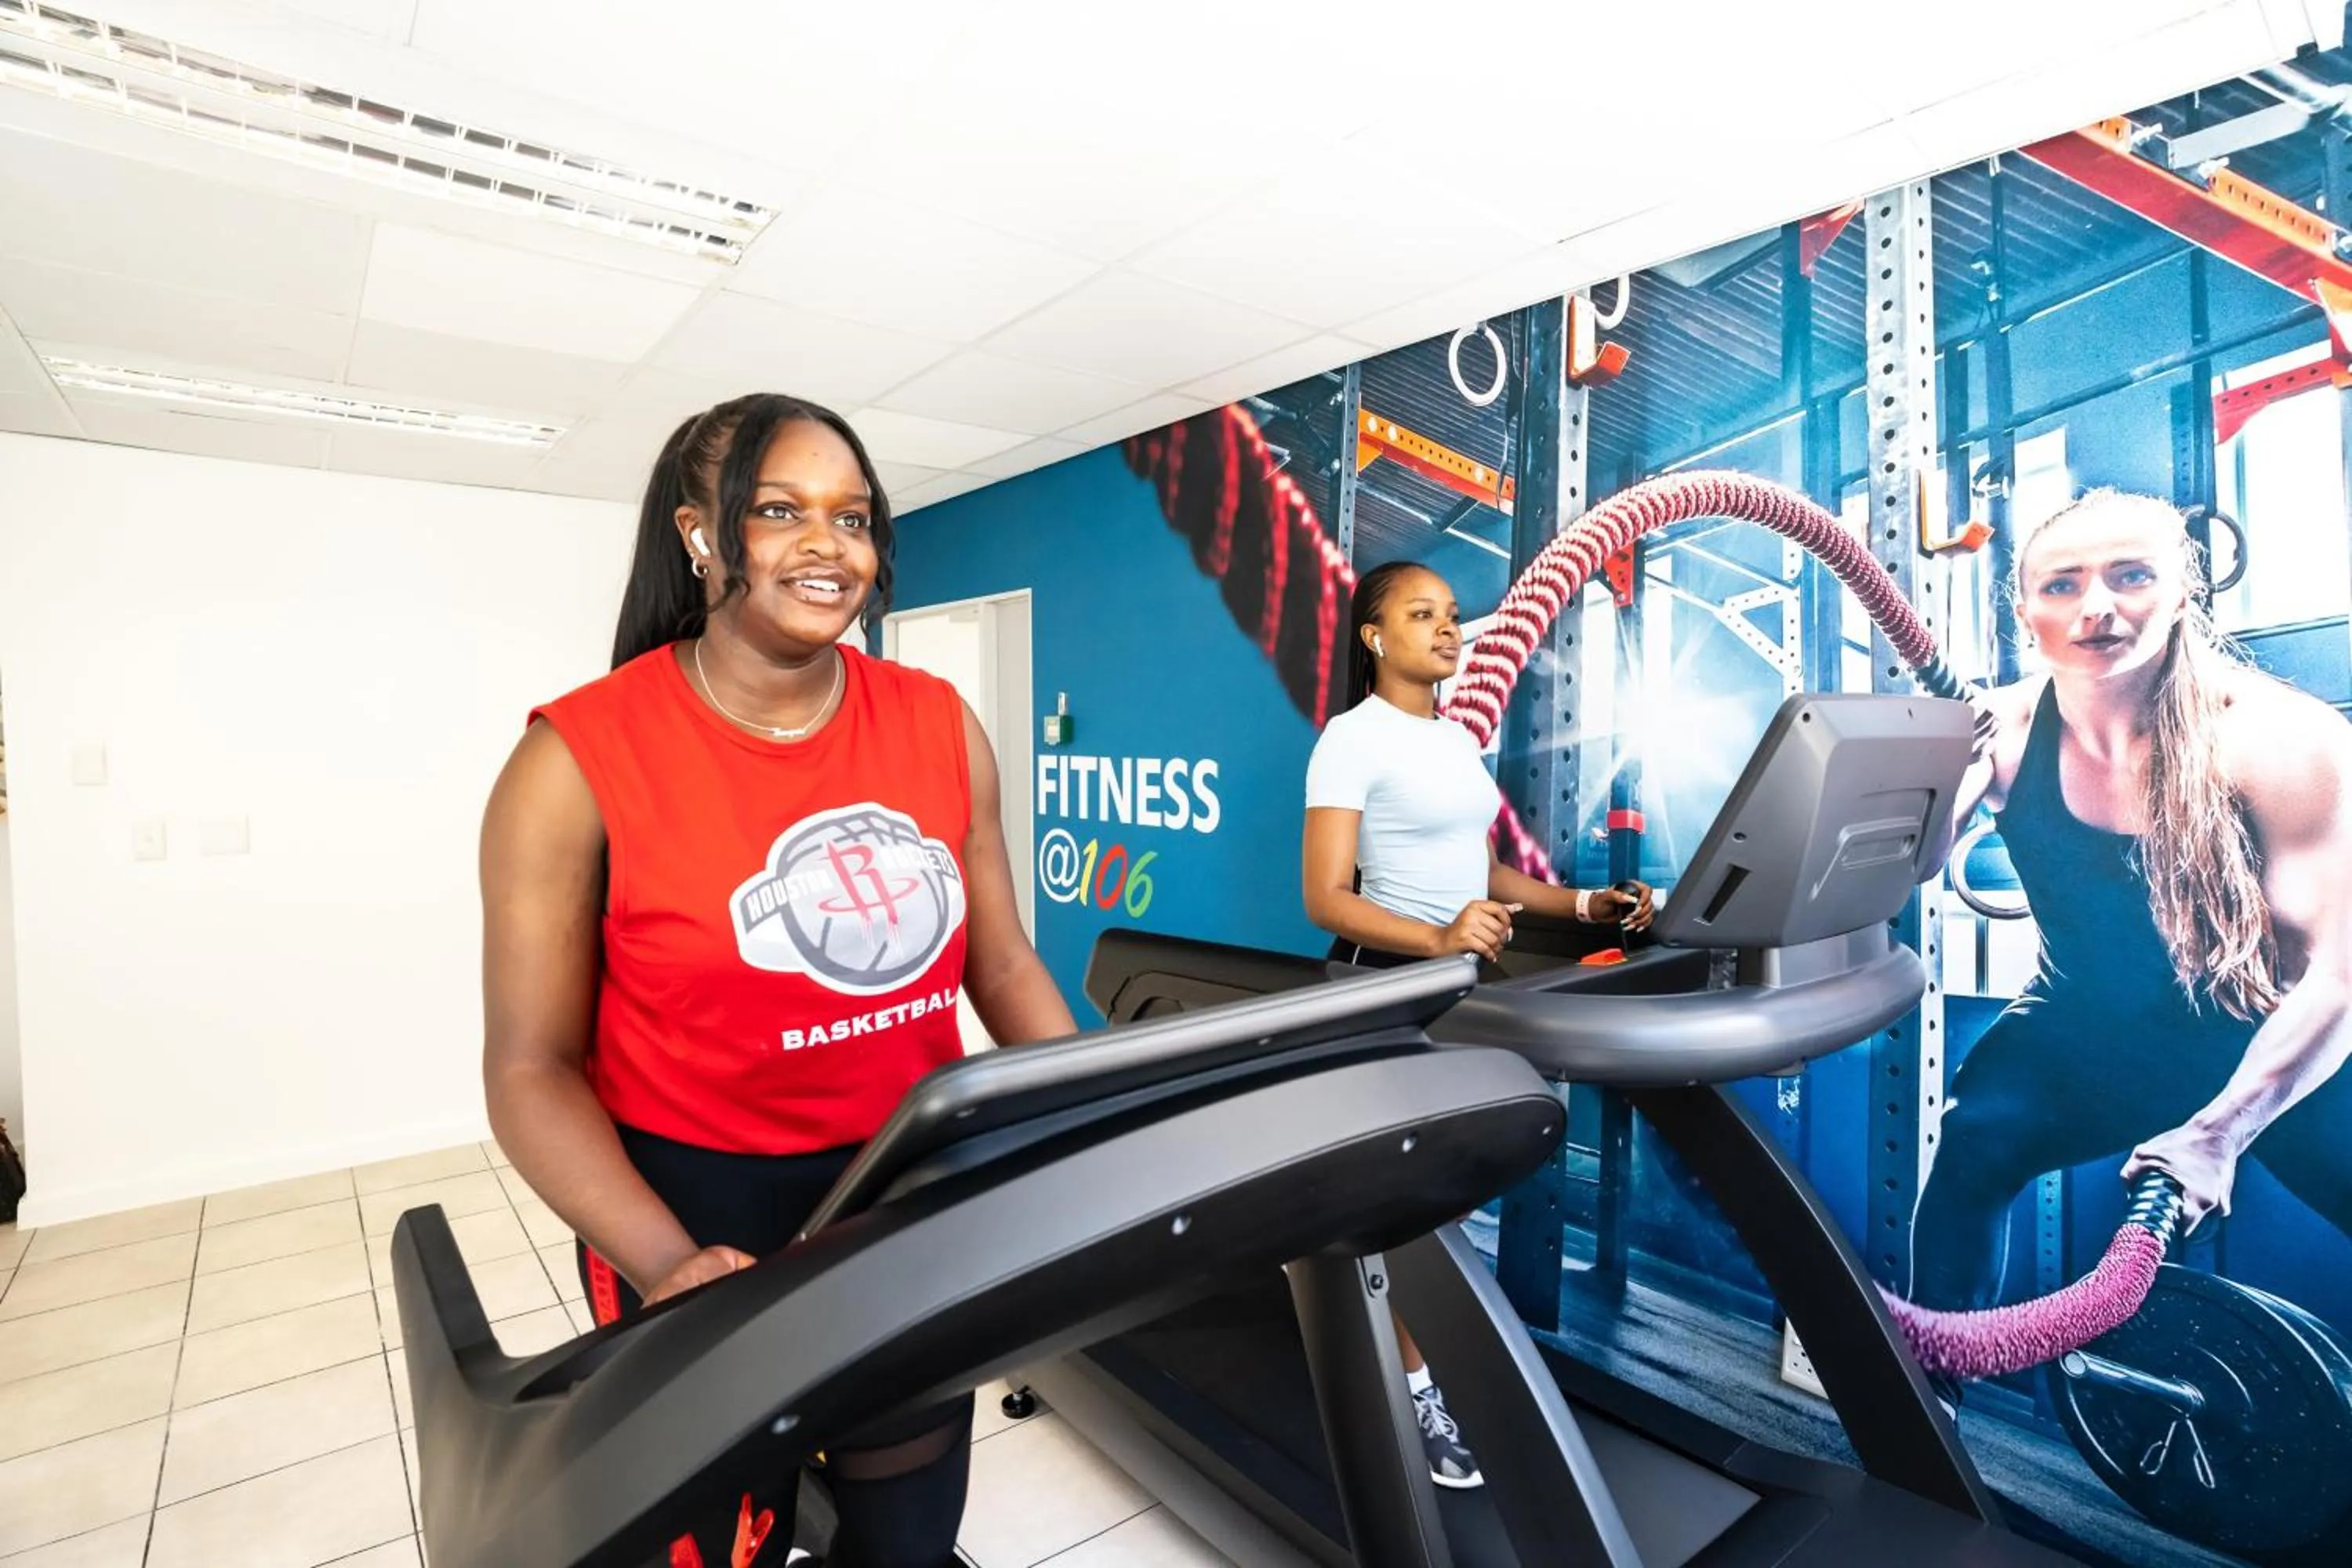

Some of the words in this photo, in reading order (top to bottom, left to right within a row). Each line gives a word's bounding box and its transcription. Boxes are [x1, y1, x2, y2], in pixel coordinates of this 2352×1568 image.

[1038, 754, 1221, 833] FITNESS
[1039, 828, 1157, 918] @106
[781, 988, 956, 1051] BASKETBAL
